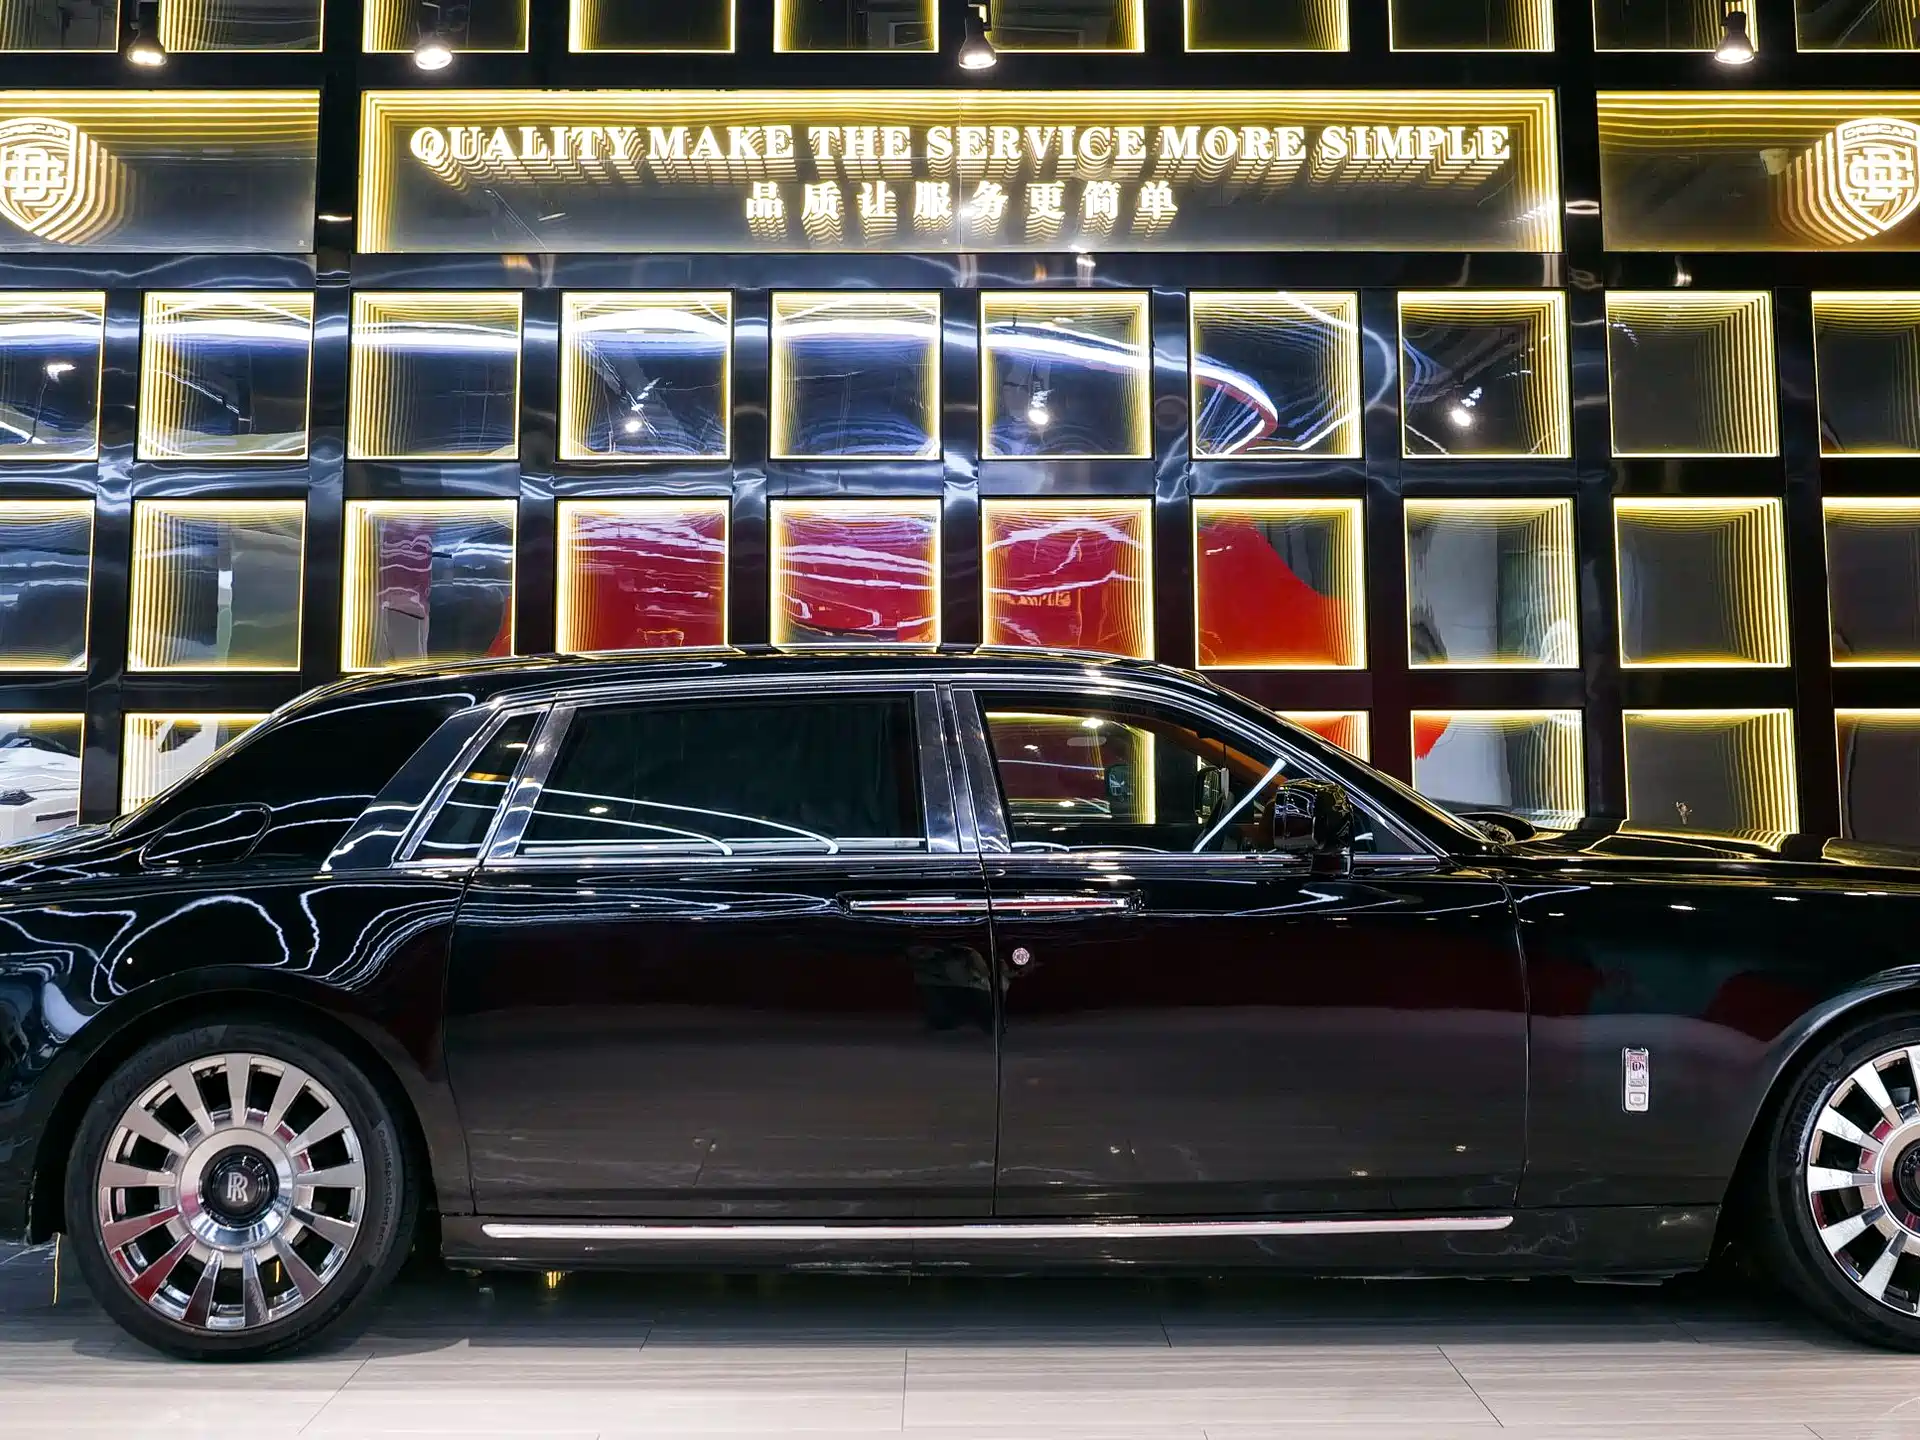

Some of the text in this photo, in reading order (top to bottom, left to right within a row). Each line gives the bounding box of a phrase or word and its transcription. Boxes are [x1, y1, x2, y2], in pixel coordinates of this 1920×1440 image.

[410, 125, 1510, 164] QUALITY MAKE THE SERVICE MORE SIMPLE
[746, 180, 1179, 220] 品质让服务更简单
[226, 1171, 249, 1203] RR
